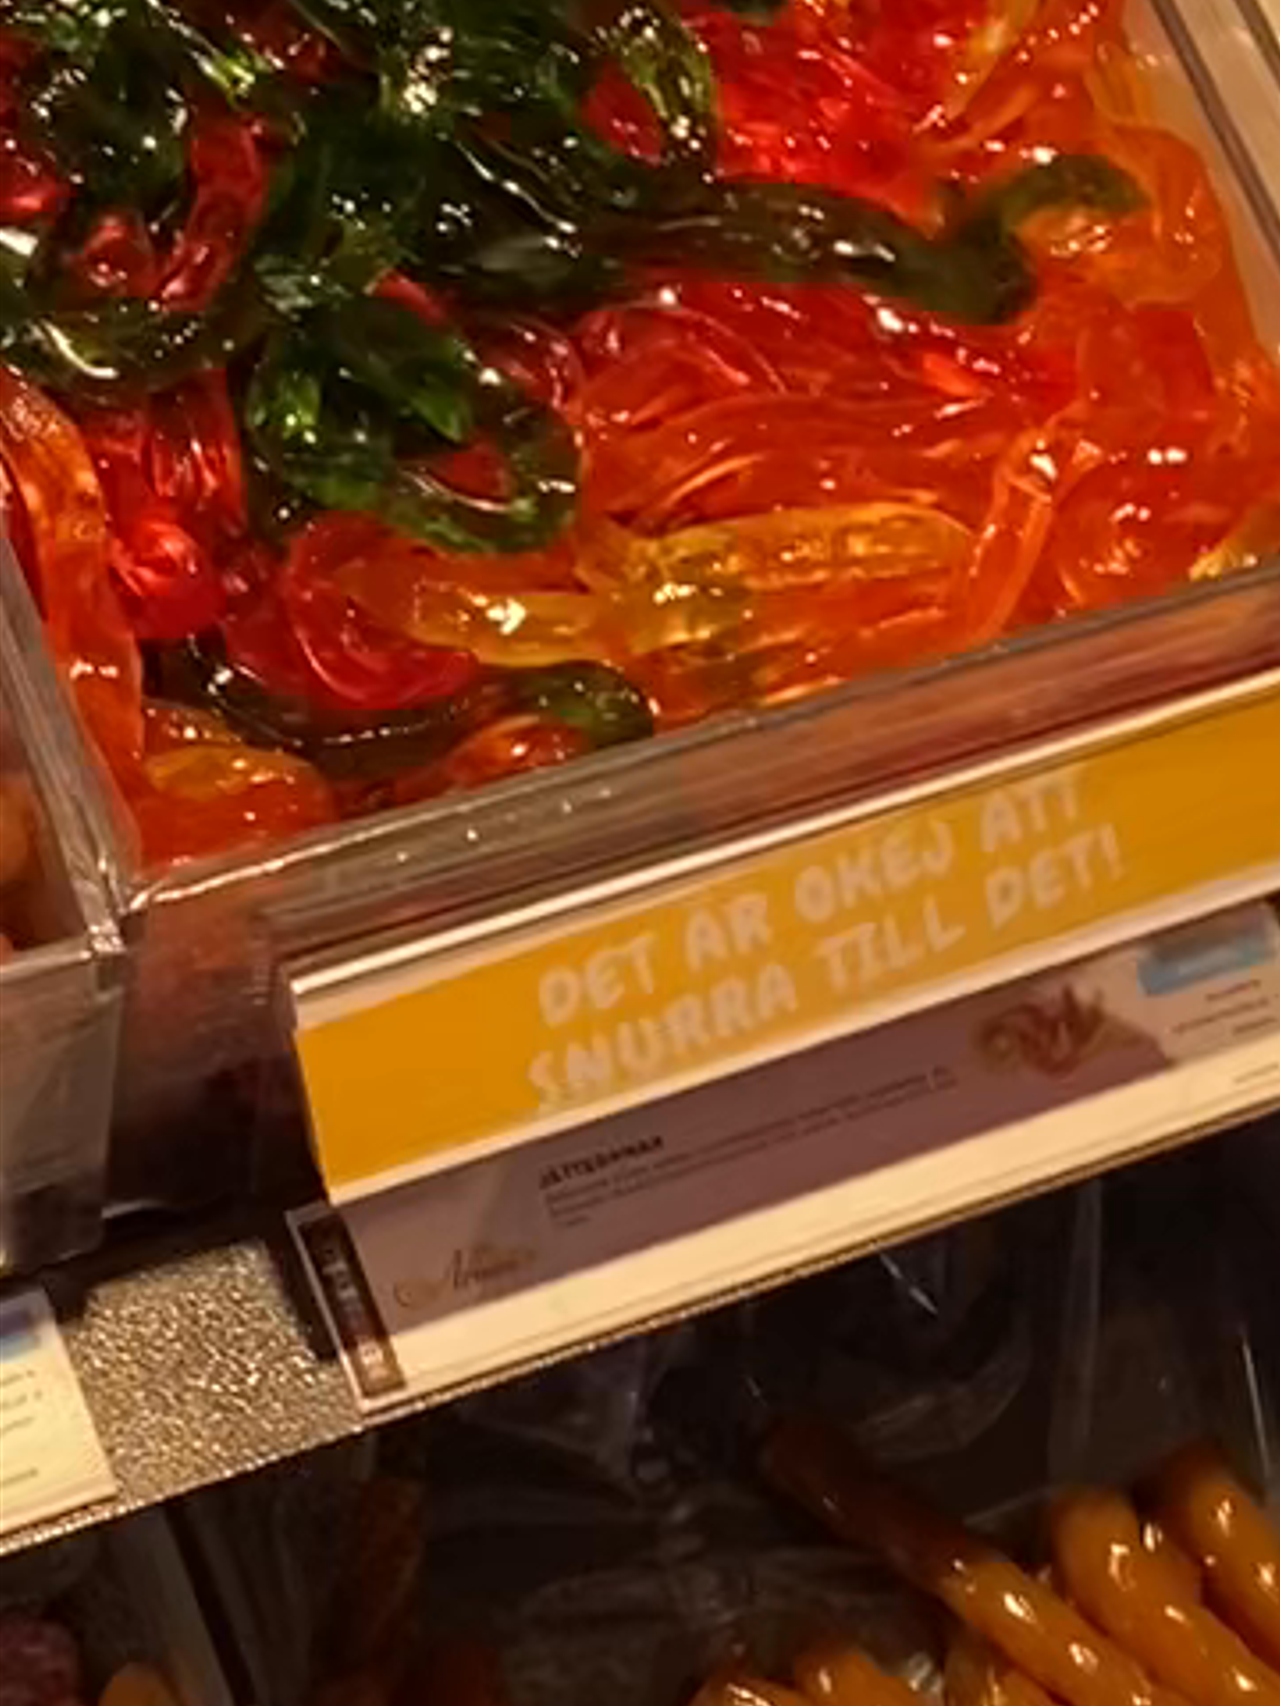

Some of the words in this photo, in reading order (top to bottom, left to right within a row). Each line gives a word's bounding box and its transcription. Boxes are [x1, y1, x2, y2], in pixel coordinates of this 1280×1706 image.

[524, 976, 799, 1114] SNURRA
[816, 915, 967, 996] TILL
[986, 822, 1124, 917] DET!
[537, 930, 660, 1030] DET
[683, 888, 773, 971] ÄR
[793, 818, 955, 918] OKEJ
[979, 769, 1087, 859] ATT
